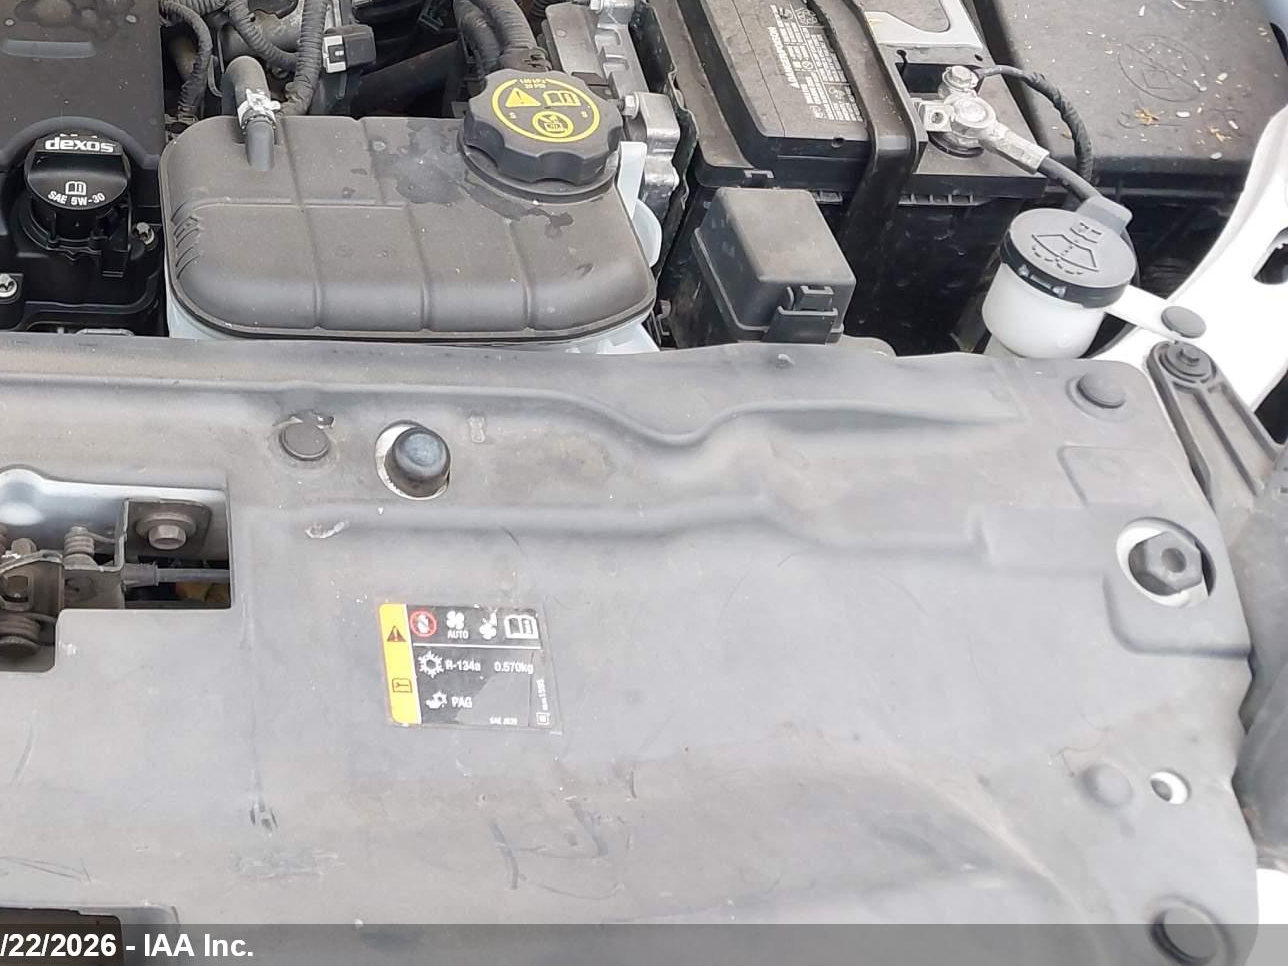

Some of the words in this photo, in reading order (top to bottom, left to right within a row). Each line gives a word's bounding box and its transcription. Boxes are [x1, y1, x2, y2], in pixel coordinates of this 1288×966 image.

[45, 137, 114, 152] dexos
[48, 191, 67, 204] SAE
[71, 193, 106, 205] 5W-30
[448, 630, 469, 639] AUTO
[445, 659, 481, 671] R-134a
[494, 661, 533, 674] 0.570kg
[452, 696, 472, 708] PAG
